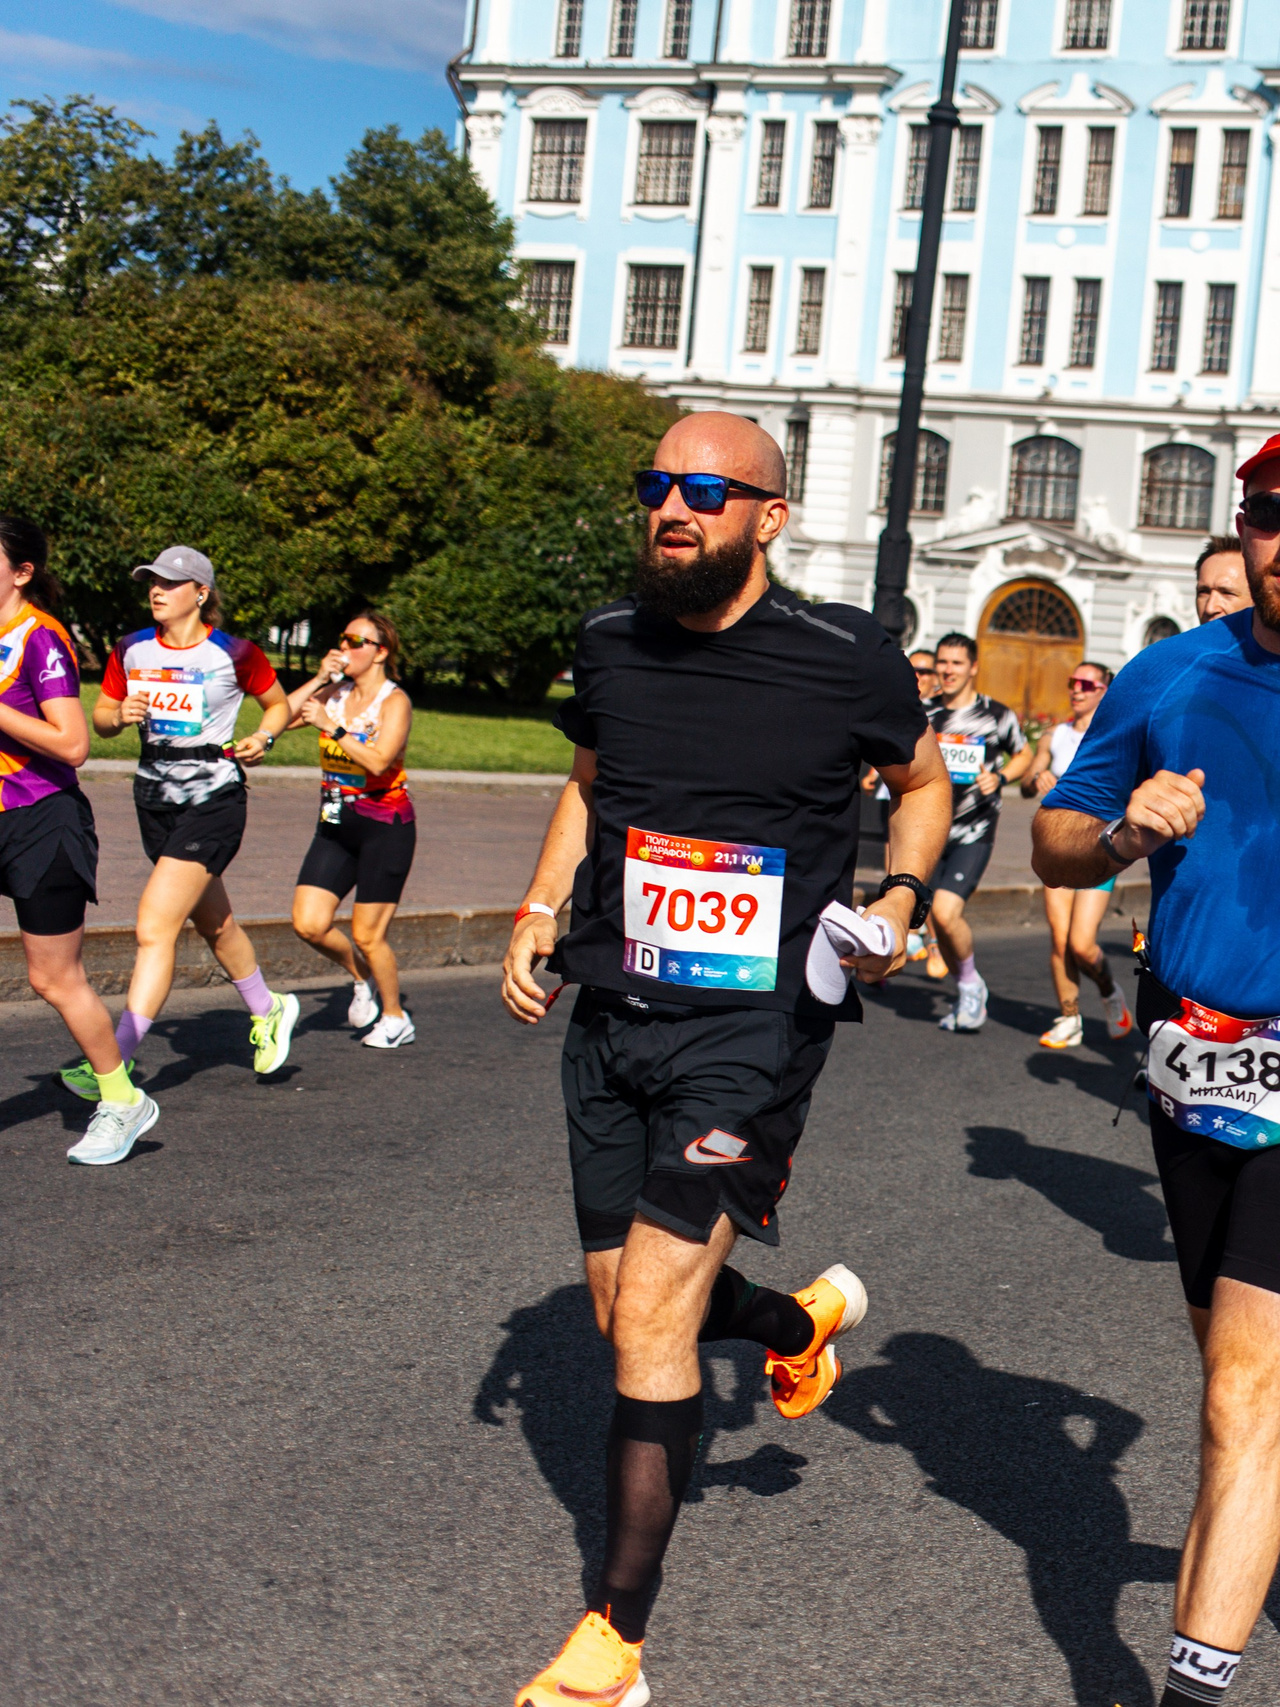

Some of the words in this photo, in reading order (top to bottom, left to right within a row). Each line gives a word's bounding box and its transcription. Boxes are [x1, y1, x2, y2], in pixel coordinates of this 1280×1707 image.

[645, 835, 670, 847] ПОЛУ
[714, 851, 738, 865] 21,1
[741, 854, 764, 866] КМ
[642, 881, 759, 936] 7039
[641, 947, 655, 971] D
[1189, 1086, 1258, 1105] МИХАИЛ
[1160, 1094, 1175, 1119] B
